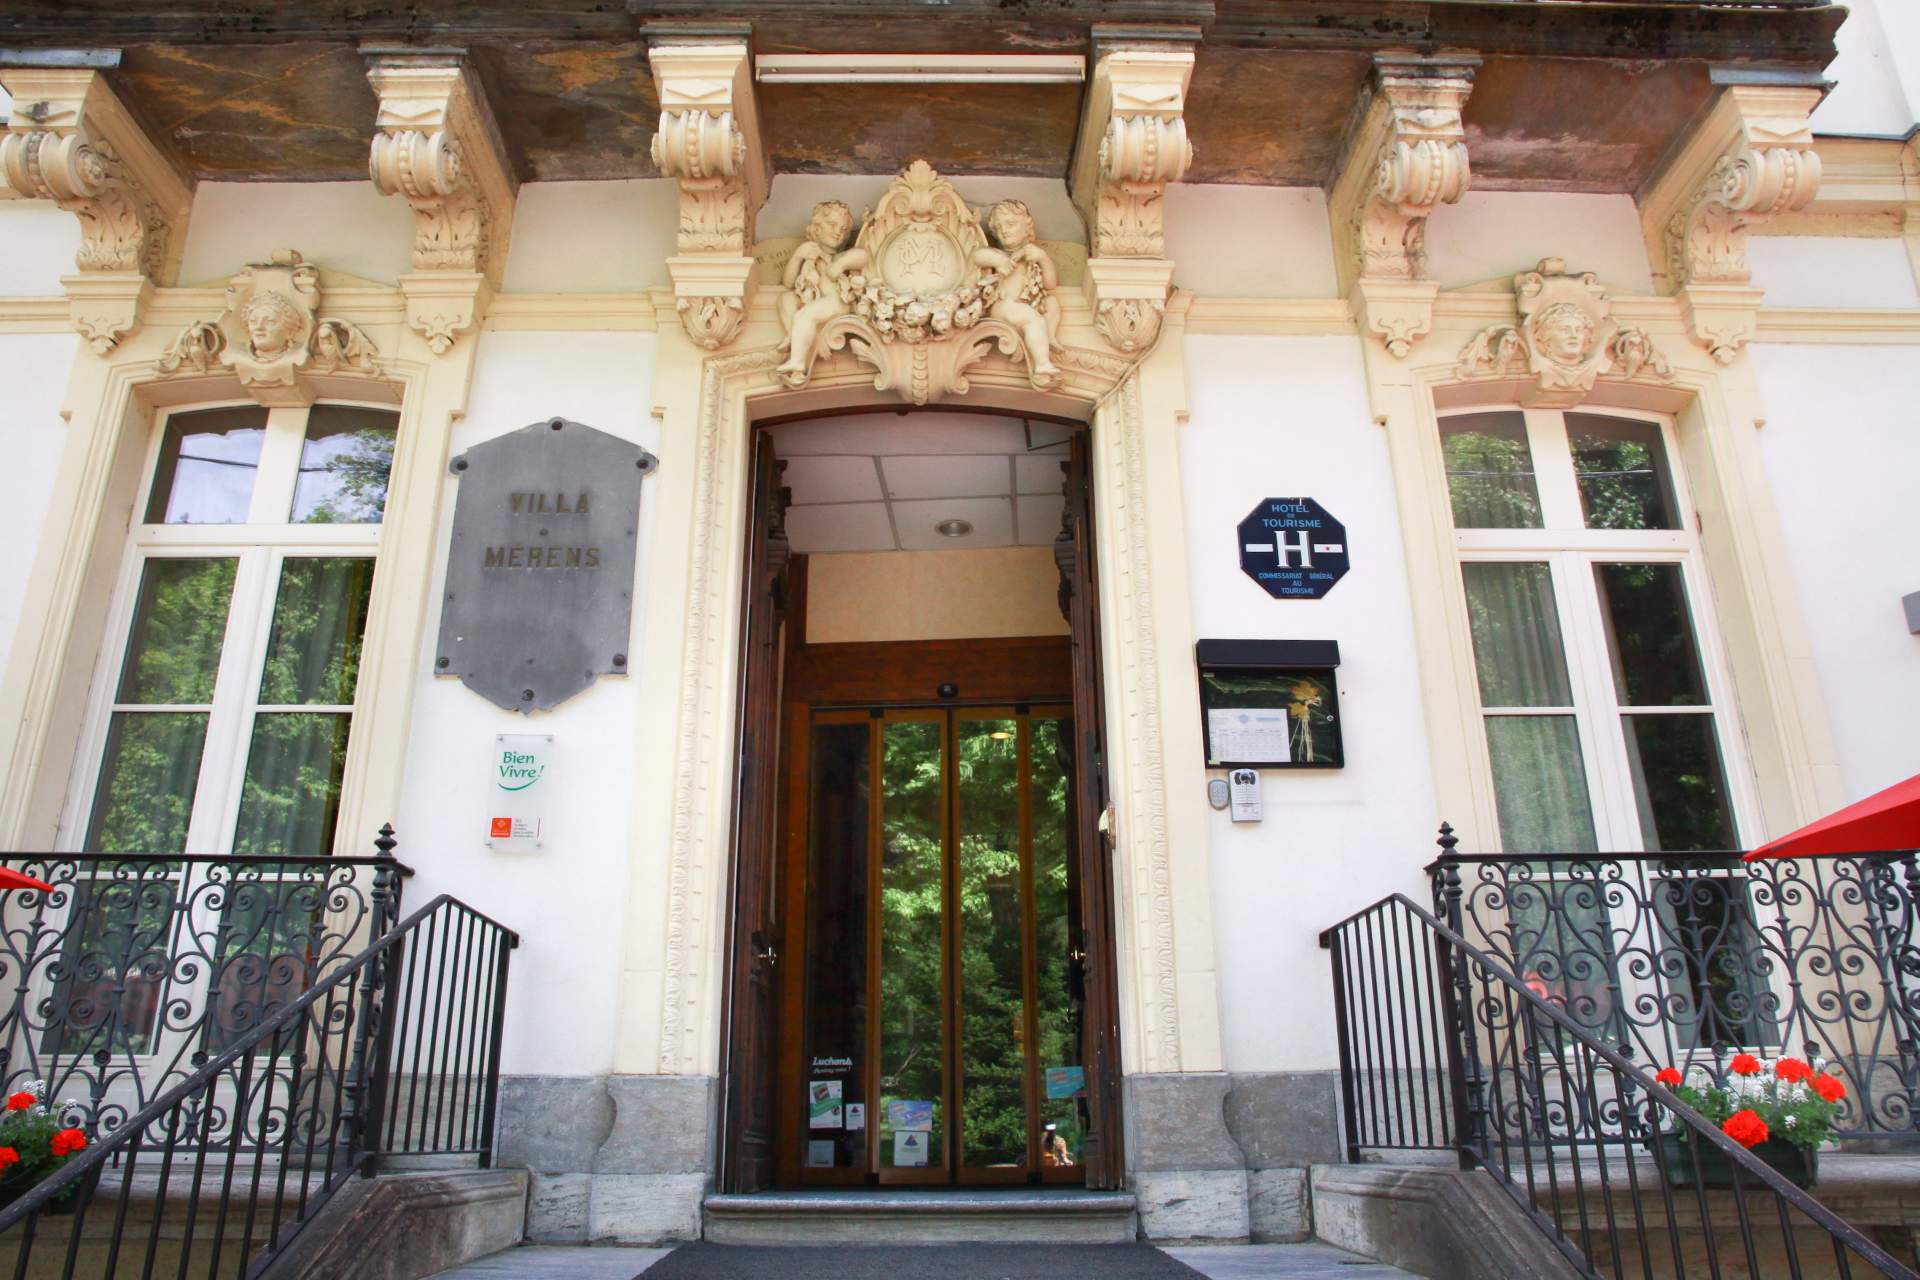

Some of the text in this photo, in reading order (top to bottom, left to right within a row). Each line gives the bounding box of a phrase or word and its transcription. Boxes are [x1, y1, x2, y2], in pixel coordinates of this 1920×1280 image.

[511, 492, 591, 514] VILLA
[1271, 504, 1310, 513] HOTEL
[1263, 518, 1322, 529] TOURISME
[1273, 530, 1315, 569] H
[1281, 587, 1314, 595] TOURISME
[503, 751, 535, 764] Bien
